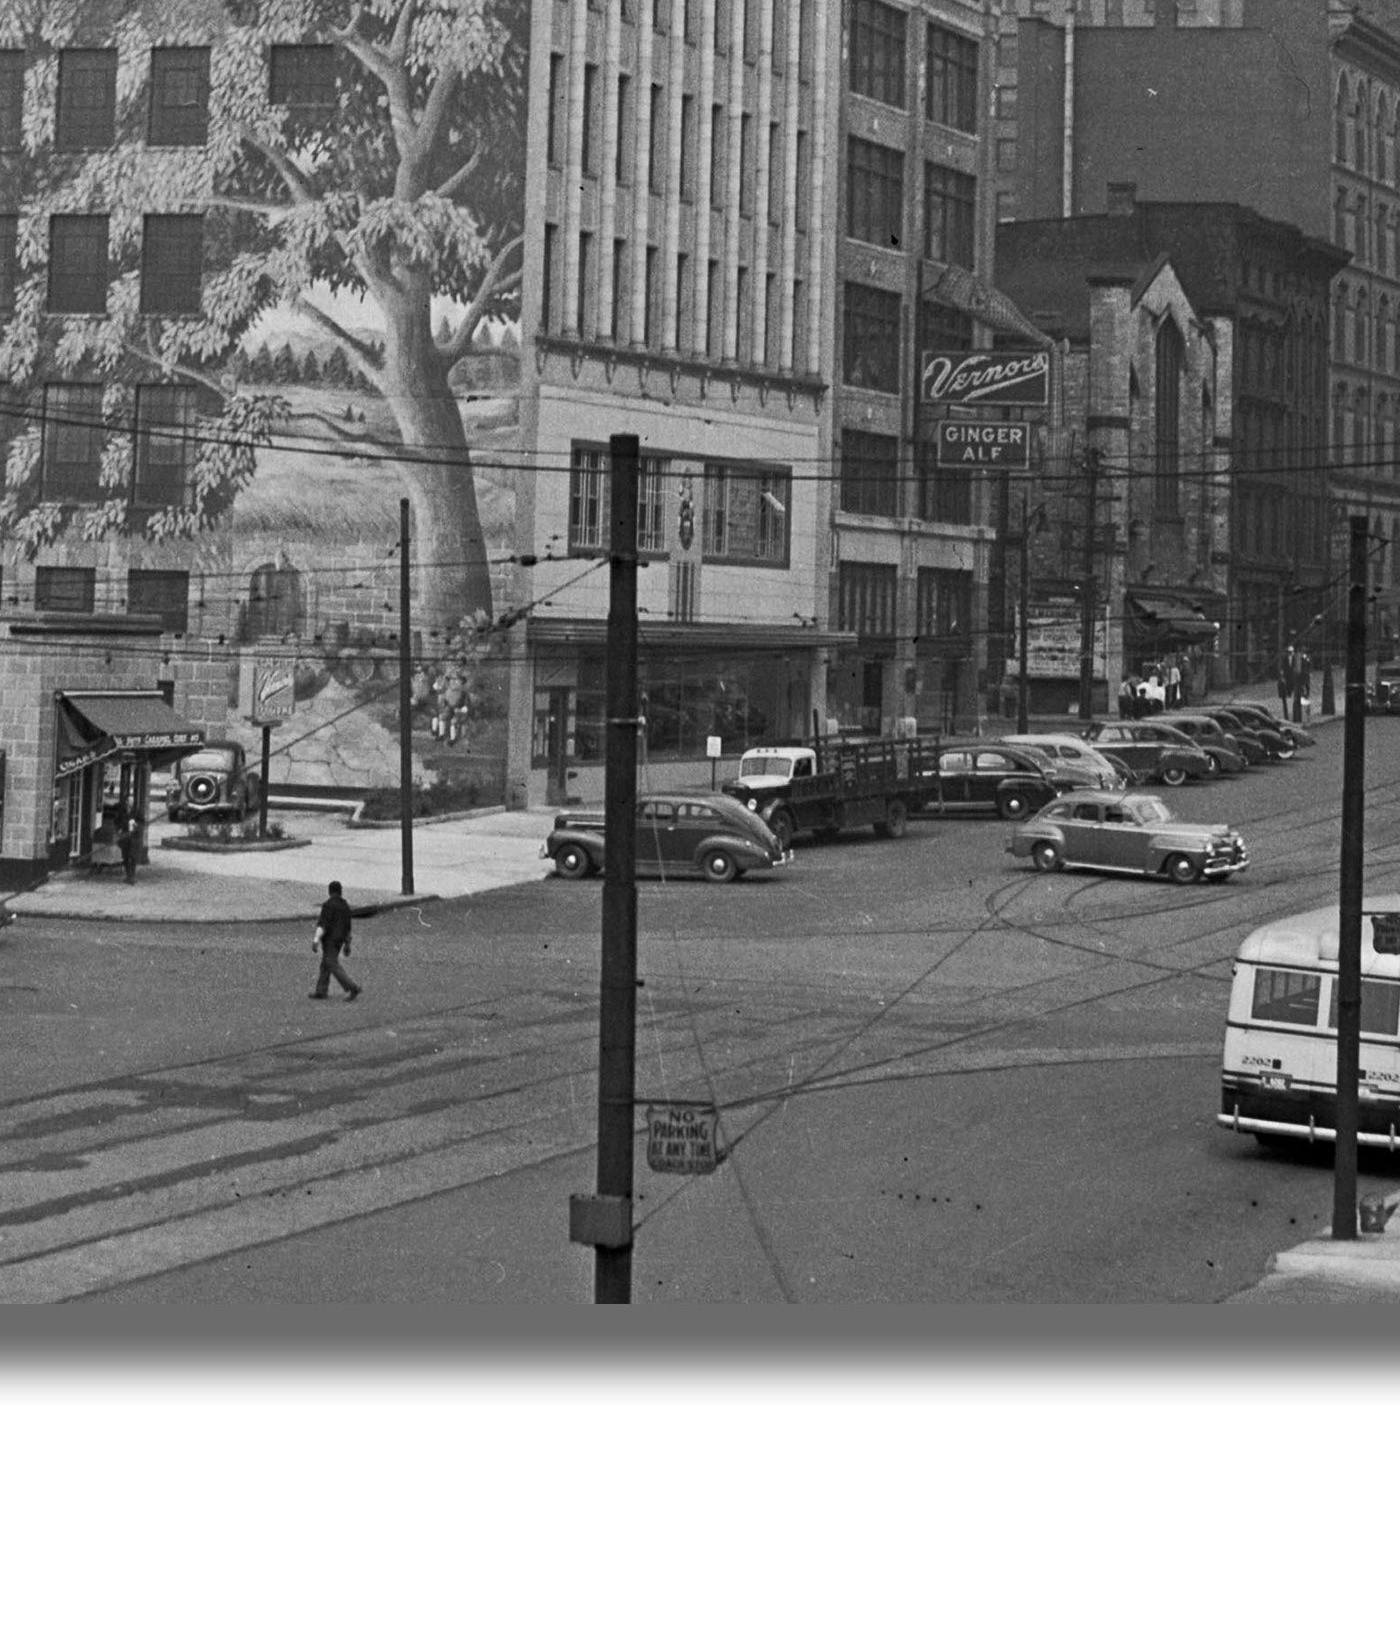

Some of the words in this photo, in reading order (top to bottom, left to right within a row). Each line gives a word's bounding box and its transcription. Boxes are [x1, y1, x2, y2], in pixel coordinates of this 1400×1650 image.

[923, 352, 1049, 403] Vernor's
[945, 426, 1023, 444] GINGER
[1241, 1055, 1272, 1067] 2202
[1368, 1071, 1400, 1083] 2202
[669, 1110, 695, 1123] NO
[653, 1120, 708, 1140] PARKING
